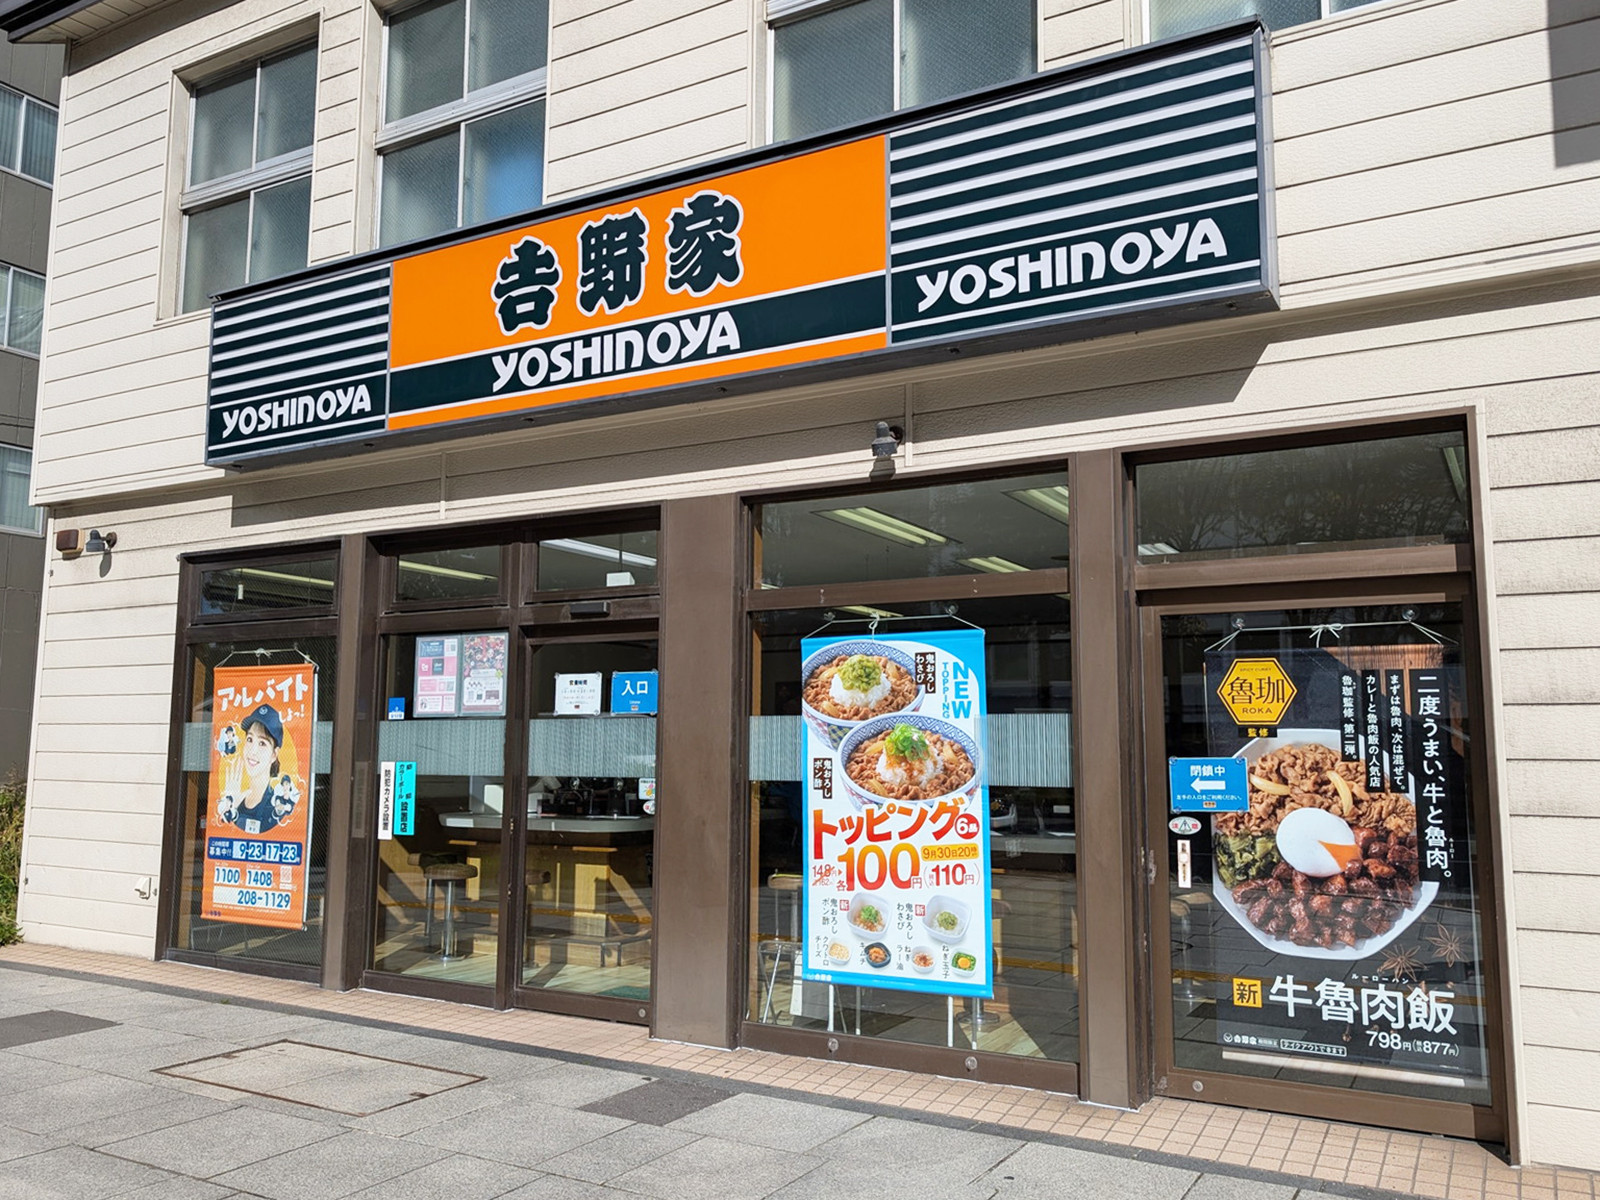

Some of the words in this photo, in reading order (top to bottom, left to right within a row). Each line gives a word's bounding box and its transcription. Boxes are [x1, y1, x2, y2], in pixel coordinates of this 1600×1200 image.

[492, 190, 743, 336] 吉野家
[916, 218, 1227, 312] YOSHINOYA
[492, 311, 740, 392] YOSHINOYA
[222, 384, 372, 438] YOSHINOYA
[916, 654, 925, 683] わさび
[926, 654, 935, 693] 鬼おろし
[217, 674, 308, 711] アルバイト
[621, 680, 648, 696] 入口
[942, 662, 950, 719] TOPPING
[952, 662, 972, 719] NEW
[1227, 676, 1285, 704] 魯珈
[1366, 675, 1381, 788] カレーと魯肉飯の人気店
[823, 760, 832, 797] 鬼おろし
[1417, 676, 1451, 878] 二度うまい、牛と魯肉。
[813, 797, 966, 860] トッピング
[215, 867, 240, 883] 1100
[247, 869, 273, 887] 1408
[238, 890, 290, 908] 208-1129
[830, 898, 838, 934] 鬼おろし
[839, 899, 849, 911] 新
[896, 902, 905, 930] わさび
[915, 904, 925, 916] 新
[905, 902, 914, 940] 鬼おろし
[1236, 982, 1259, 1005] 新
[1269, 974, 1458, 1036] 牛魯肉飯
[1283, 1040, 1344, 1054] テイクアウトできます
